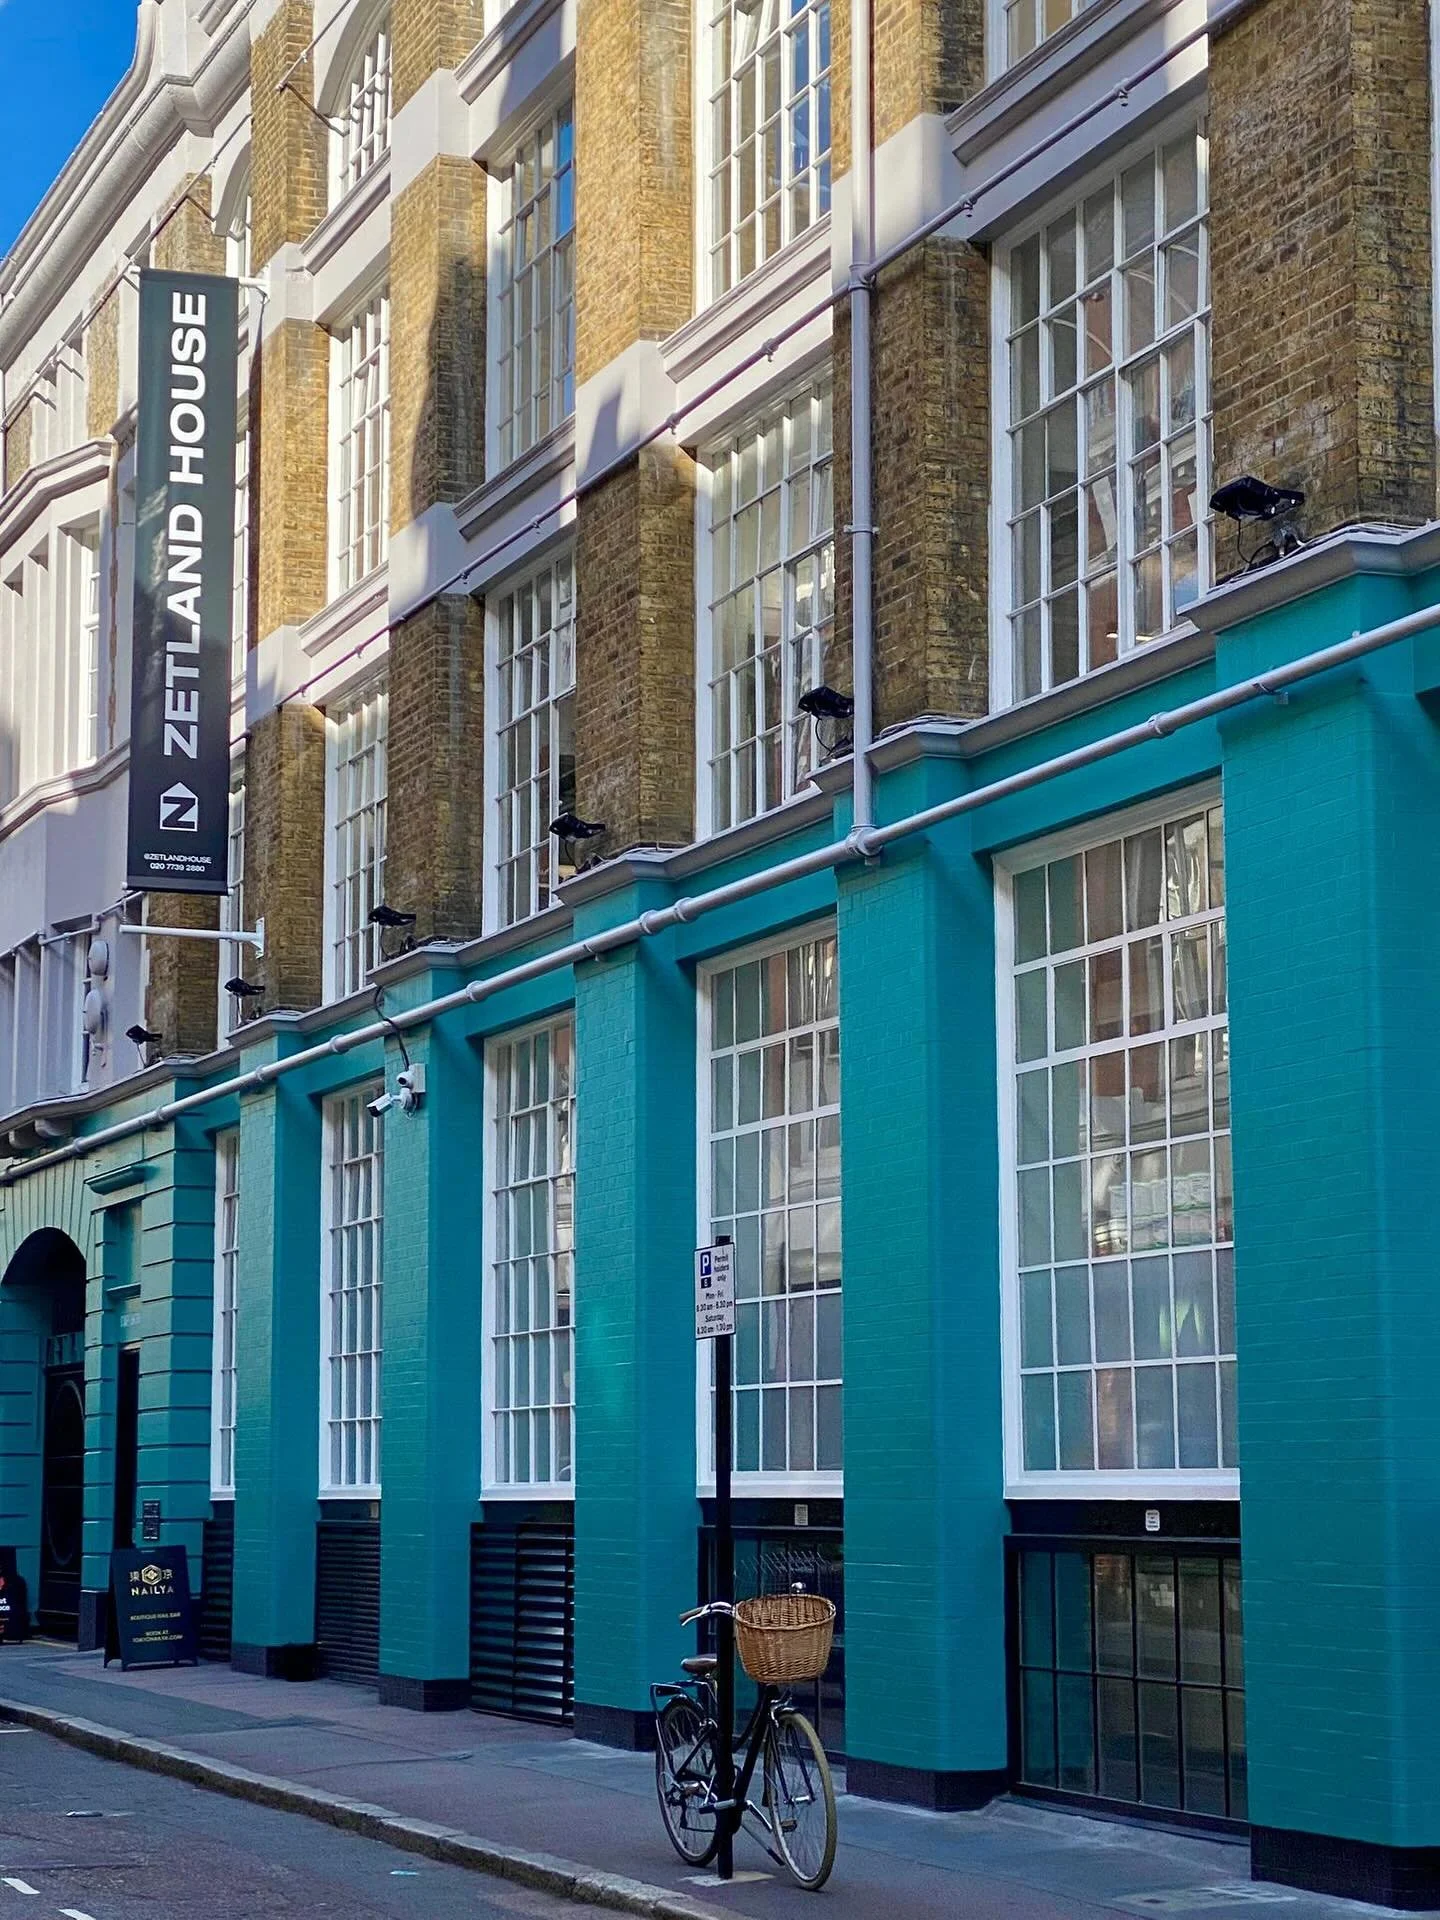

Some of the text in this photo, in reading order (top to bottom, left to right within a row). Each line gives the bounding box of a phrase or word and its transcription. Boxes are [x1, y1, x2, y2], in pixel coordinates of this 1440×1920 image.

[163, 291, 207, 759] ZETLAND HOUSE
[150, 862, 165, 870] 020
[166, 863, 185, 871] 7739
[714, 1254, 729, 1263] Permit
[702, 1254, 709, 1274] P
[713, 1263, 730, 1273] holders
[717, 1273, 726, 1282] only
[131, 1584, 174, 1596] NAILYA
